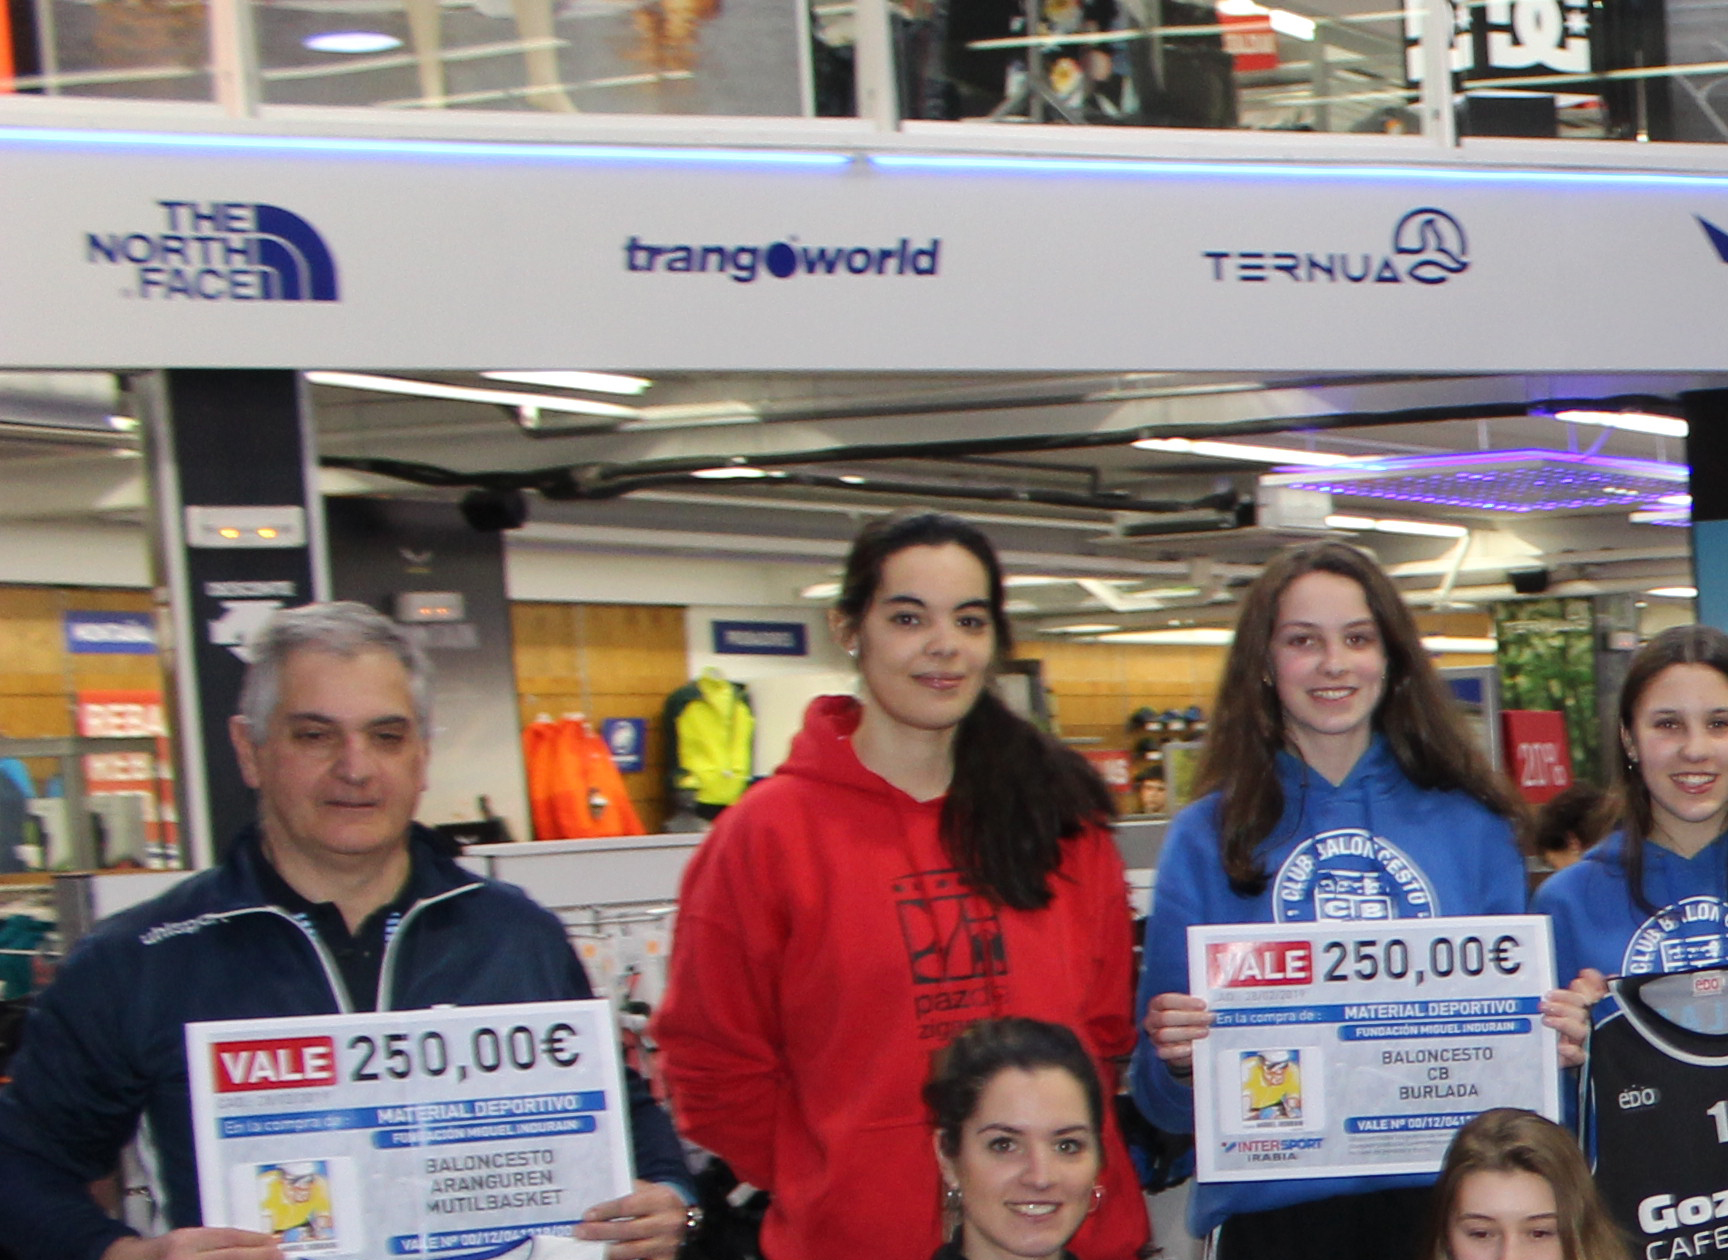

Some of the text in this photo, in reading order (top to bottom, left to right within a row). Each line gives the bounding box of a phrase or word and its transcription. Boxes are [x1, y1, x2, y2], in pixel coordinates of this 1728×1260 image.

[159, 202, 256, 233] THE
[86, 234, 258, 265] NORTH
[1202, 252, 1401, 283] TERNUA
[141, 267, 259, 300] FACE
[1216, 935, 1522, 985] VALE 250,00€
[1345, 1000, 1515, 1019] MATERIAL DEPORTIVO
[220, 1023, 580, 1084] VALE 250,00€
[1382, 1047, 1493, 1065] BALONCESTO
[1427, 1066, 1449, 1081] CB
[1399, 1084, 1479, 1100] BURLADA
[377, 1095, 577, 1124] MATERIAL DEPORTIVO
[1238, 1138, 1323, 1153] INTERSPORT
[1248, 1152, 1297, 1162] IRABIA
[427, 1150, 554, 1174] BALONCESTO
[431, 1170, 553, 1195] ARANGUREN
[428, 1190, 563, 1214] MUTILBASKET
